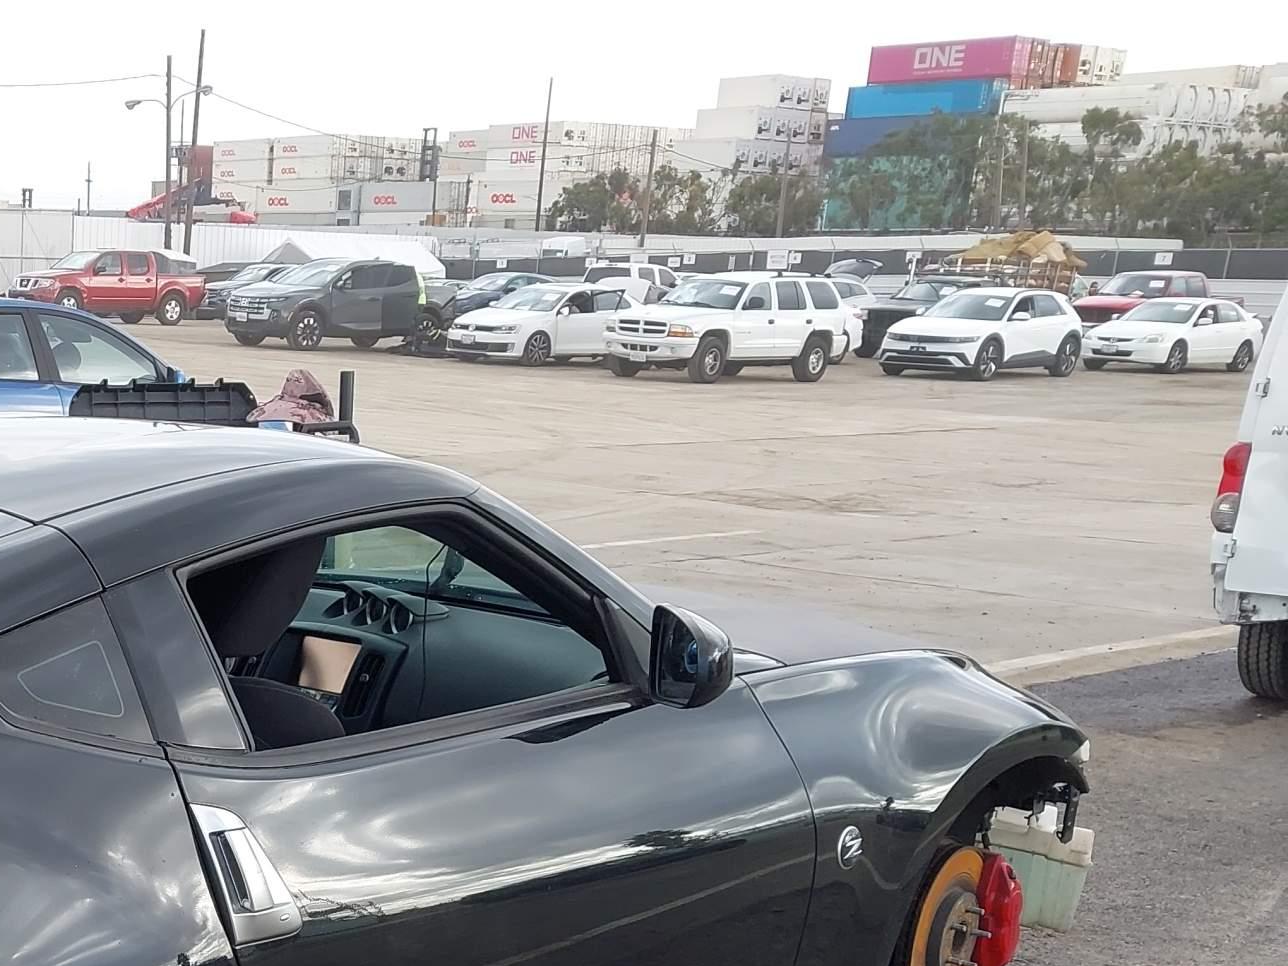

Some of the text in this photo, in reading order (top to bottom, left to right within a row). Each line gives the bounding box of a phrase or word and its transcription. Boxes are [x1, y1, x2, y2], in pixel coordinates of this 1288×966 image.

[913, 45, 966, 69] ONE
[512, 126, 538, 140] ONE
[458, 140, 476, 148] OOCL
[510, 150, 536, 164] ONE
[268, 196, 289, 207] OOCL
[374, 195, 397, 205] OOCL
[491, 193, 516, 204] OOCL
